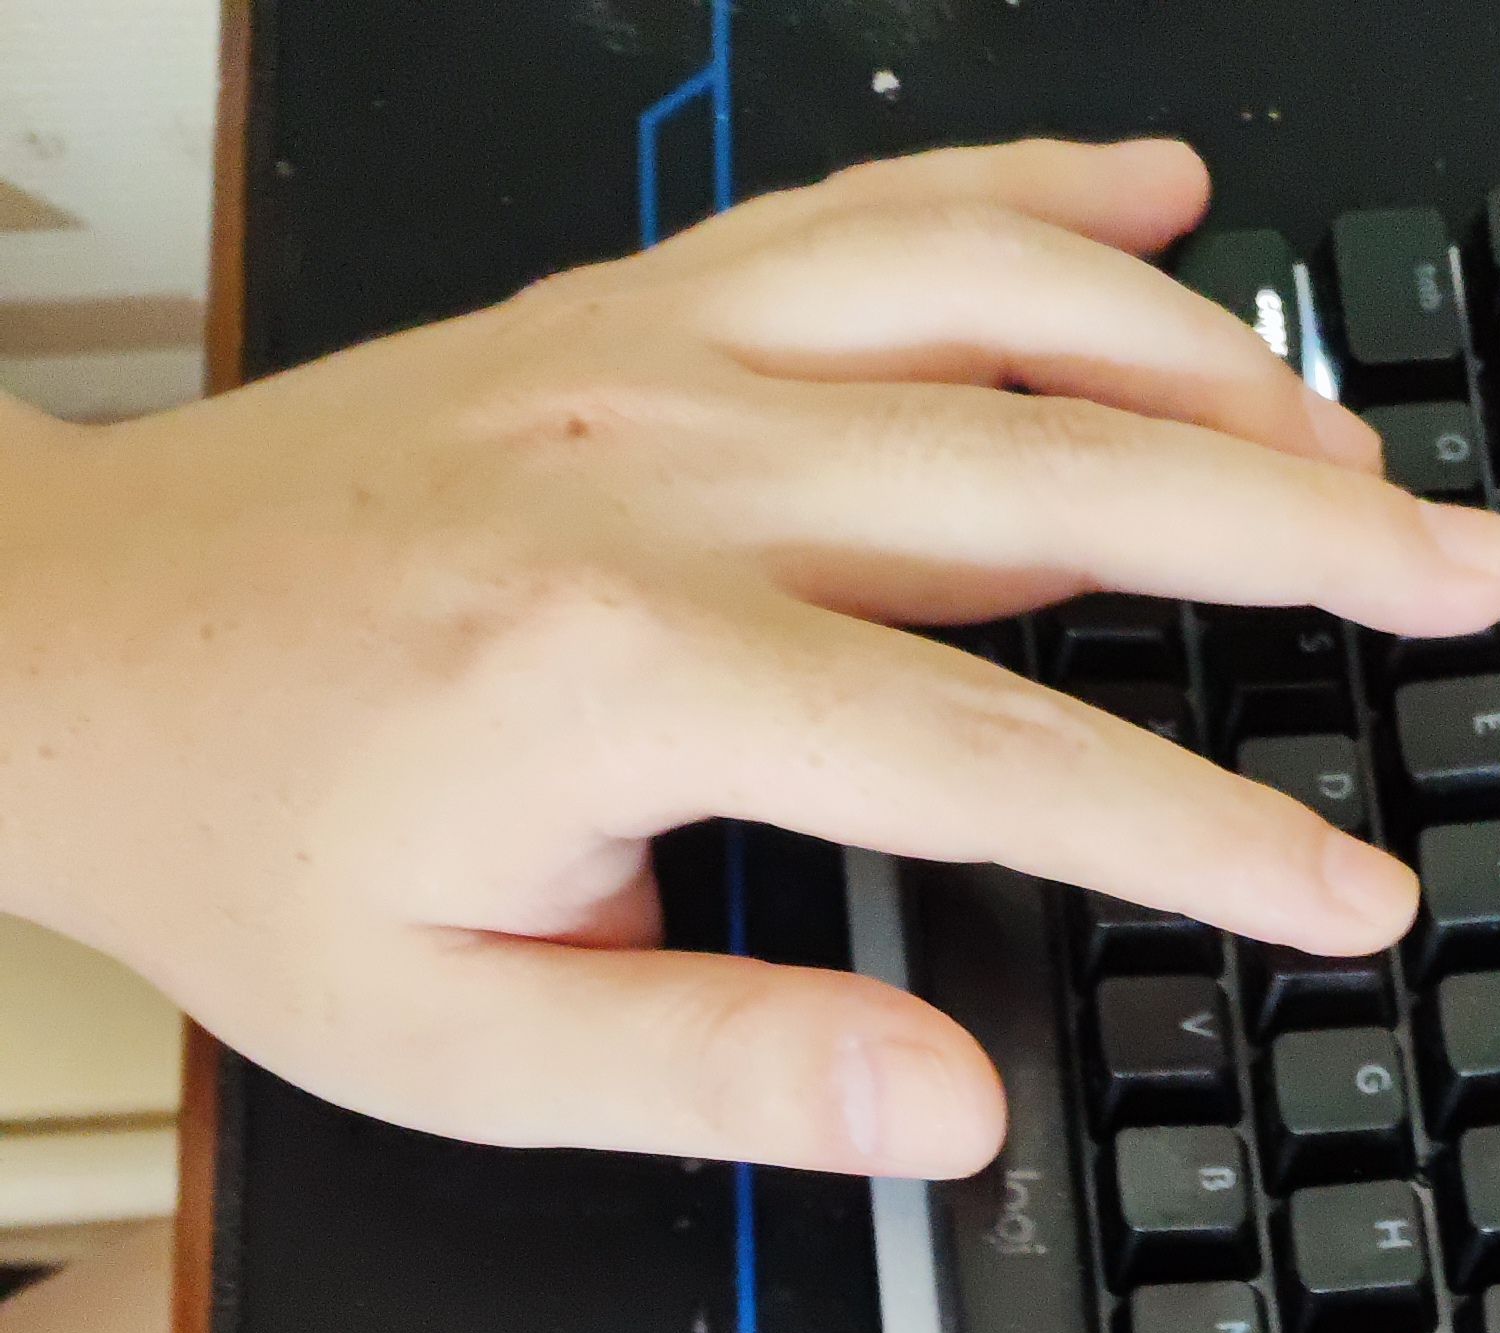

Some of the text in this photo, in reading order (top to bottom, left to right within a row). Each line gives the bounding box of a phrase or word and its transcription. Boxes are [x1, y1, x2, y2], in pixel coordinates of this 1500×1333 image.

[1255, 288, 1290, 357] cap
[1434, 435, 1471, 462] Q
[1179, 1011, 1218, 1038] V
[1356, 1064, 1394, 1095] G
[1199, 1165, 1237, 1192] B
[1374, 1218, 1413, 1249] H
